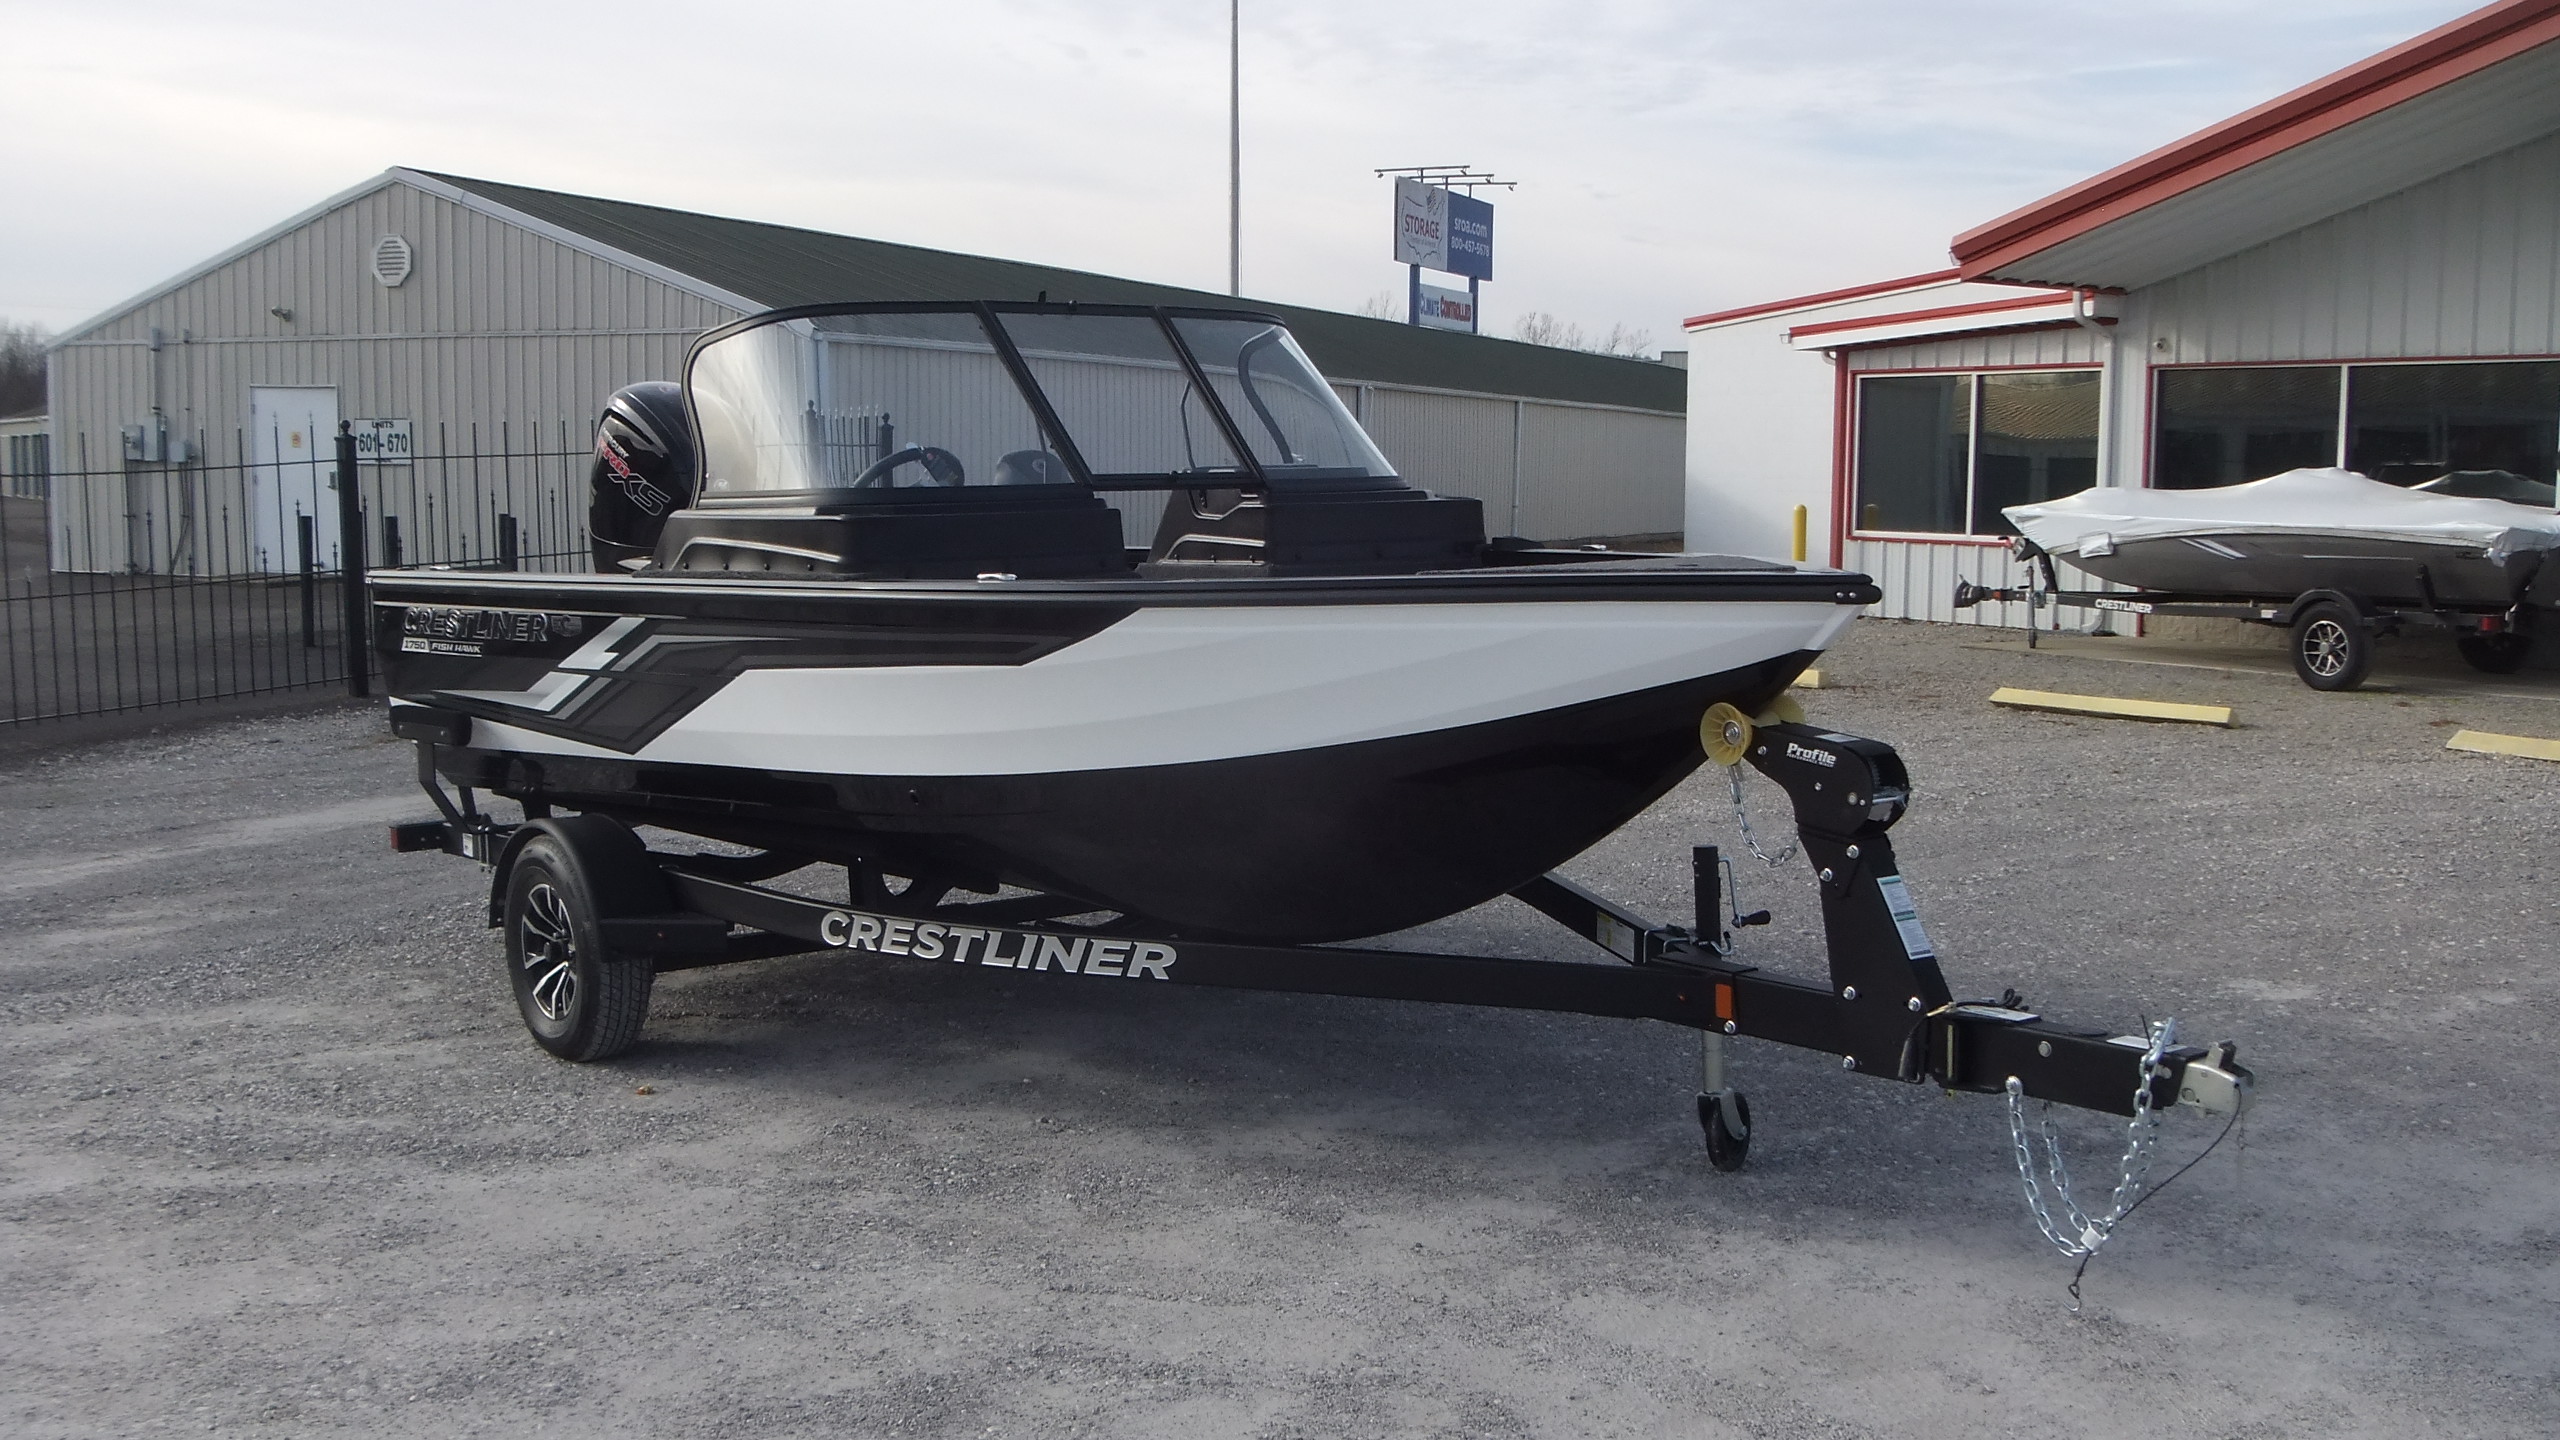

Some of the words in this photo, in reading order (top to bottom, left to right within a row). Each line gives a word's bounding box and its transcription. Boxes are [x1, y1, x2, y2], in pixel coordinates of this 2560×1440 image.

[1405, 214, 1440, 240] STORAGE
[1454, 217, 1488, 238] sroa.com
[2095, 599, 2152, 613] CRESTLINER
[403, 606, 547, 642] CRESTLINER
[404, 639, 425, 650] 1750
[431, 642, 455, 652] FISH
[456, 644, 481, 654] HAWK
[1786, 742, 1837, 765] Profile
[820, 910, 1177, 981] CRESTLINER
